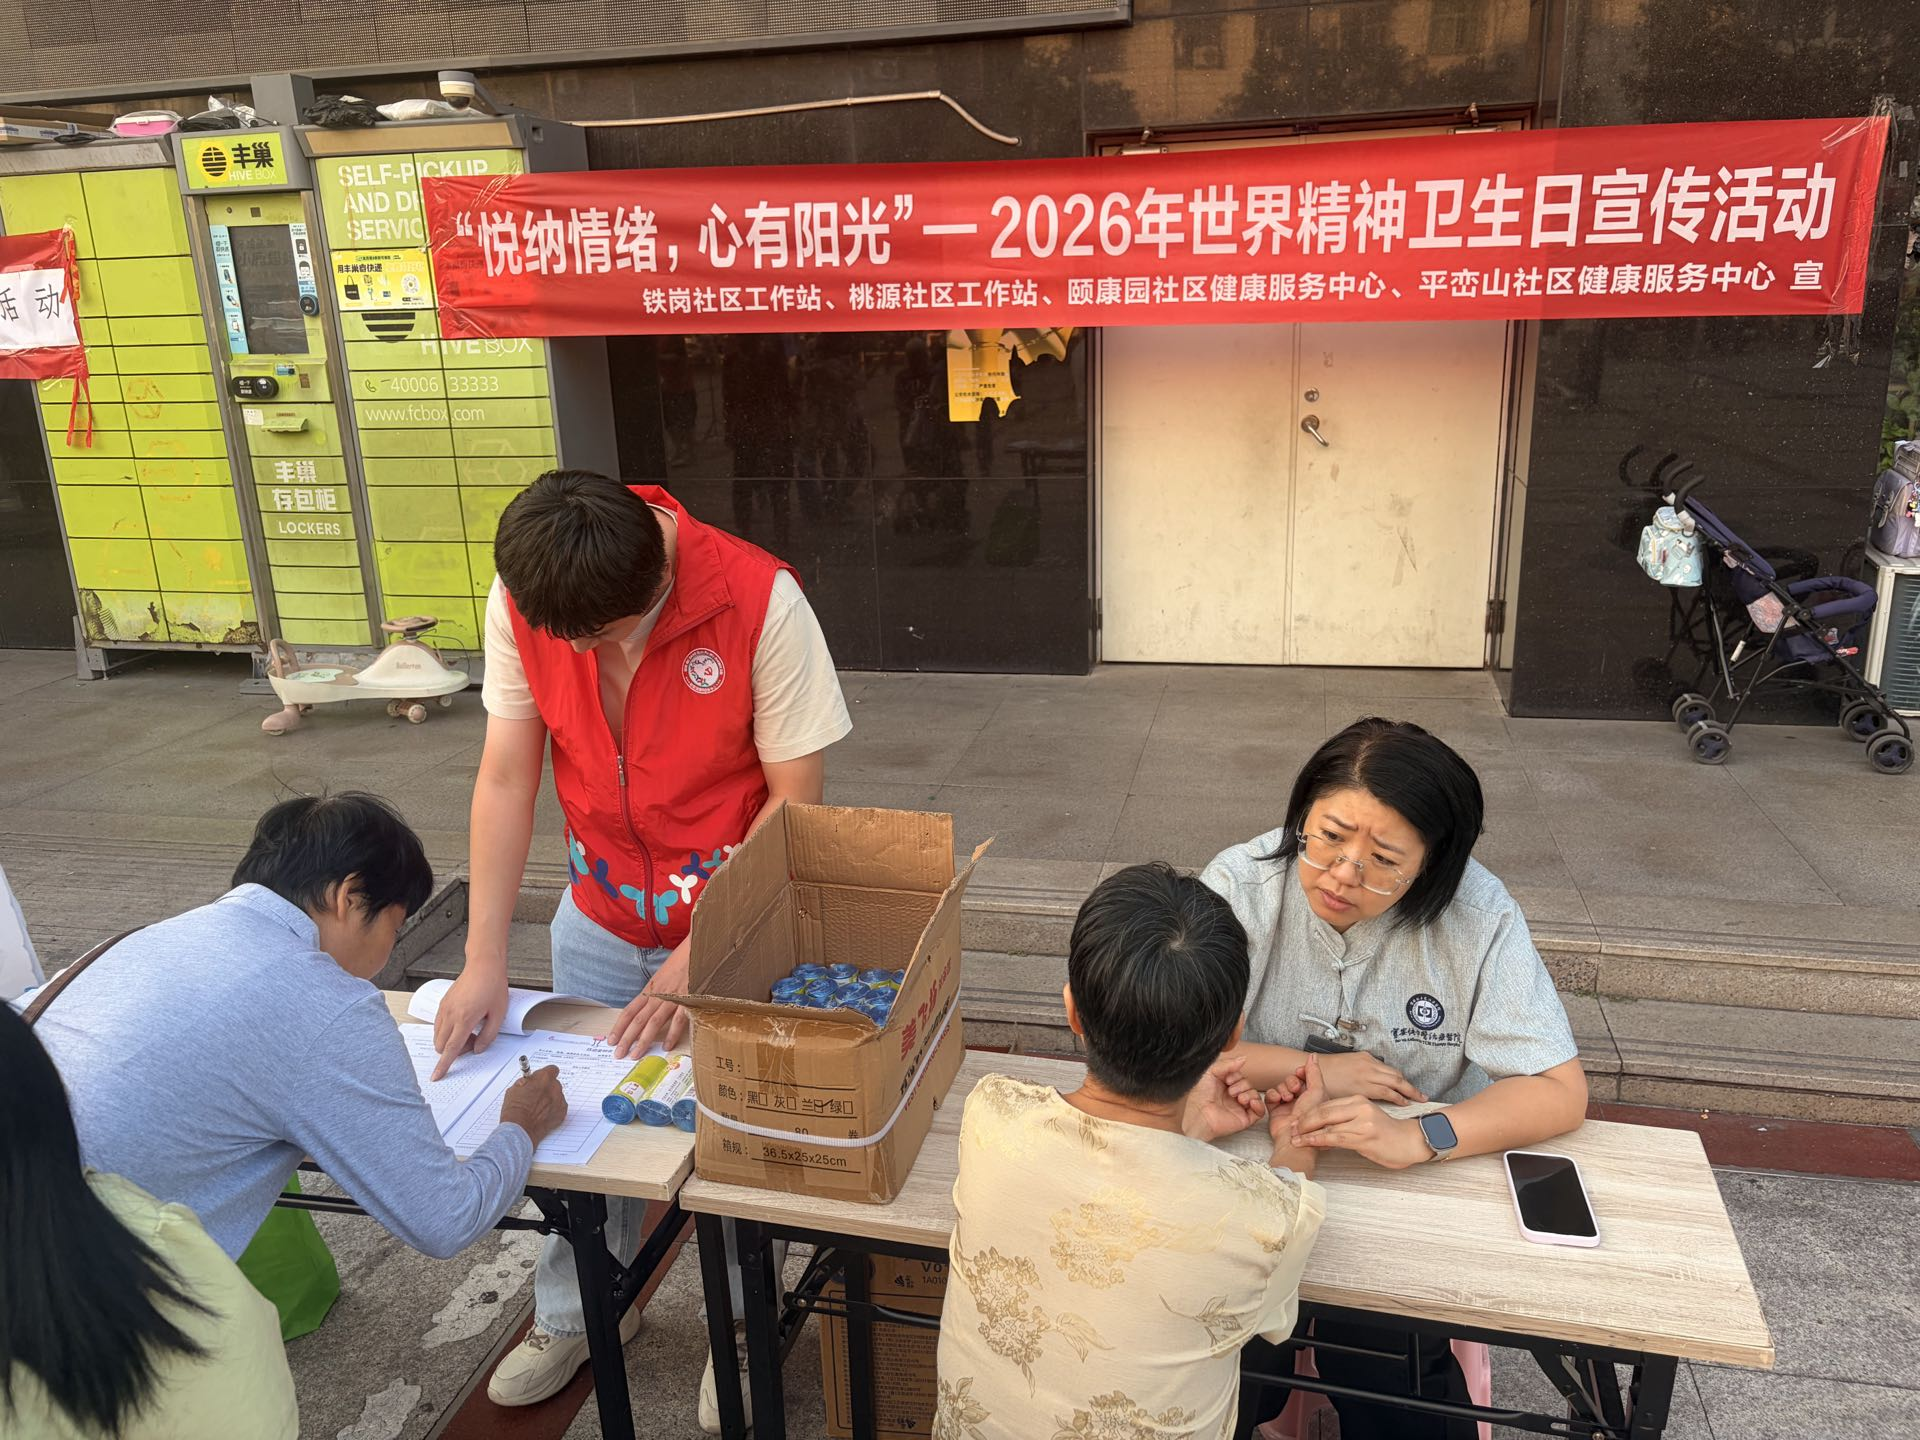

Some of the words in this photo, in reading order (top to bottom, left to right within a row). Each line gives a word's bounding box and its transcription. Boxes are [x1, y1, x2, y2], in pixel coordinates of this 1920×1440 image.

[231, 141, 274, 169] 丰巢
[228, 170, 253, 181] HIVE
[255, 168, 276, 179] BOX
[343, 191, 390, 214] AND
[347, 217, 425, 241] SERVIC
[1789, 260, 1824, 291] 宣
[420, 333, 481, 355] HIVE
[484, 337, 533, 355] BOX
[365, 404, 486, 421] www.fcbox.com
[274, 460, 317, 483] 丰巢
[272, 488, 337, 511] 存包柜
[278, 521, 341, 536] LOCKERS
[762, 1146, 847, 1168] 36.5x25x25cm
